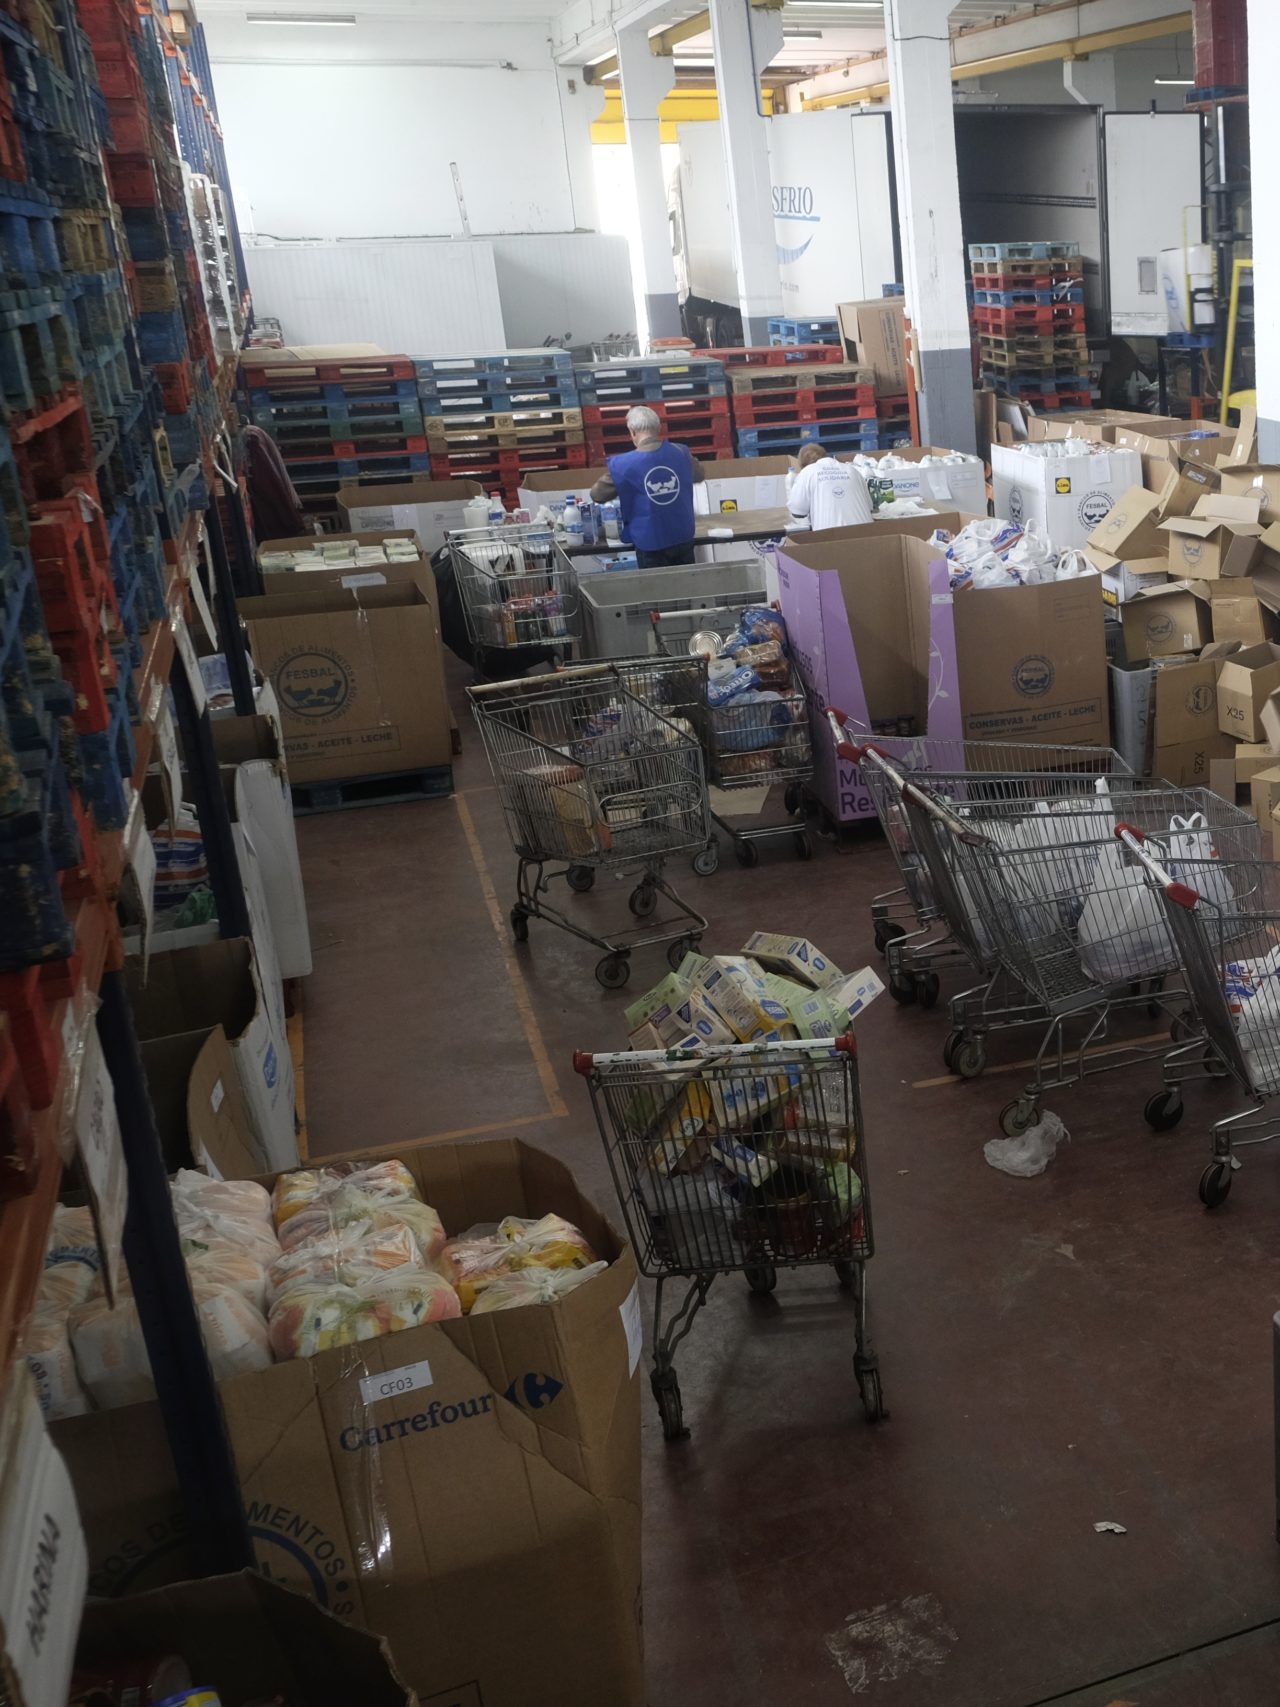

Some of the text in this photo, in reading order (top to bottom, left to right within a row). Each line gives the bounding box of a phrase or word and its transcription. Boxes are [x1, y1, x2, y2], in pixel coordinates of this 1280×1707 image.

[287, 667, 335, 680] FESBAL
[969, 716, 1024, 730] CONSERVAS
[1031, 712, 1062, 723] ACEITE
[1069, 704, 1097, 716] LECHE
[1226, 705, 1245, 721] X25
[318, 737, 352, 748] ACEITE
[361, 733, 393, 743] LECHE
[1193, 751, 1205, 775] X25
[380, 1376, 414, 1396] CF03
[339, 1393, 493, 1452] Carrefour
